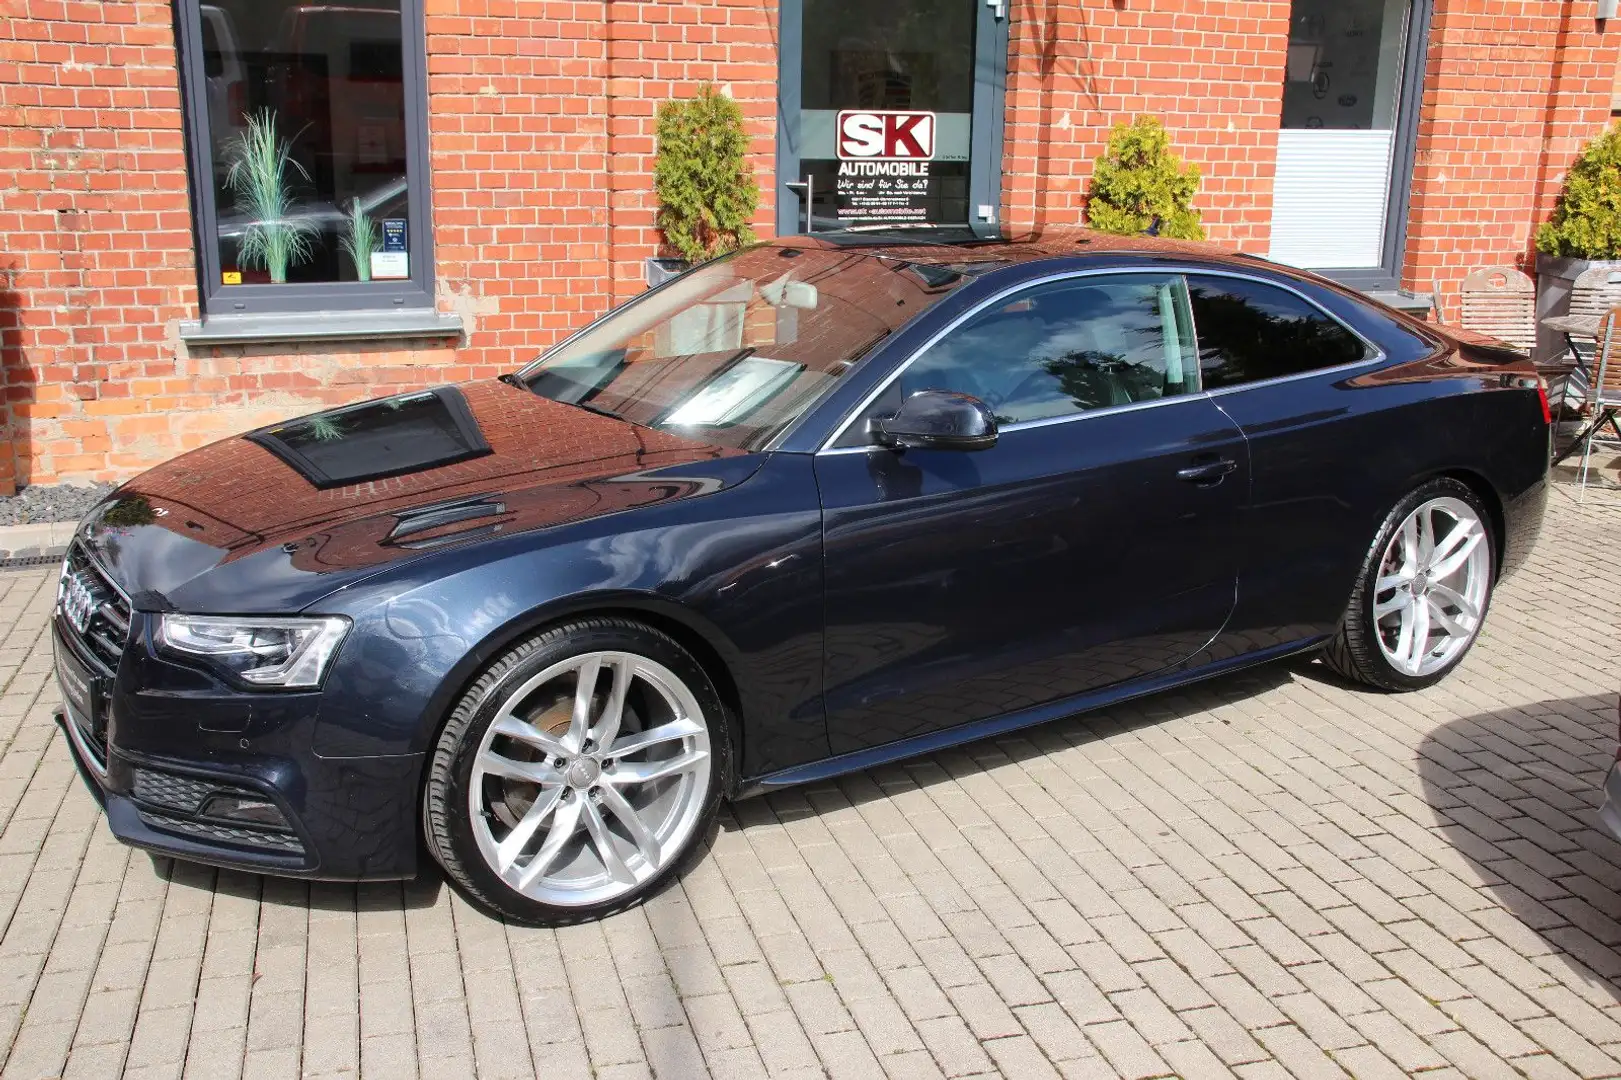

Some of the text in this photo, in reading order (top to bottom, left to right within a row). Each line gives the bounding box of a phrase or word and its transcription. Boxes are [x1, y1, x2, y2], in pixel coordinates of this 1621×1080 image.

[842, 114, 928, 157] SK
[838, 162, 929, 176] AUTOMOBILE
[837, 179, 854, 189] Wir
[857, 179, 875, 189] sind
[878, 179, 892, 189] für
[895, 179, 909, 189] Sie
